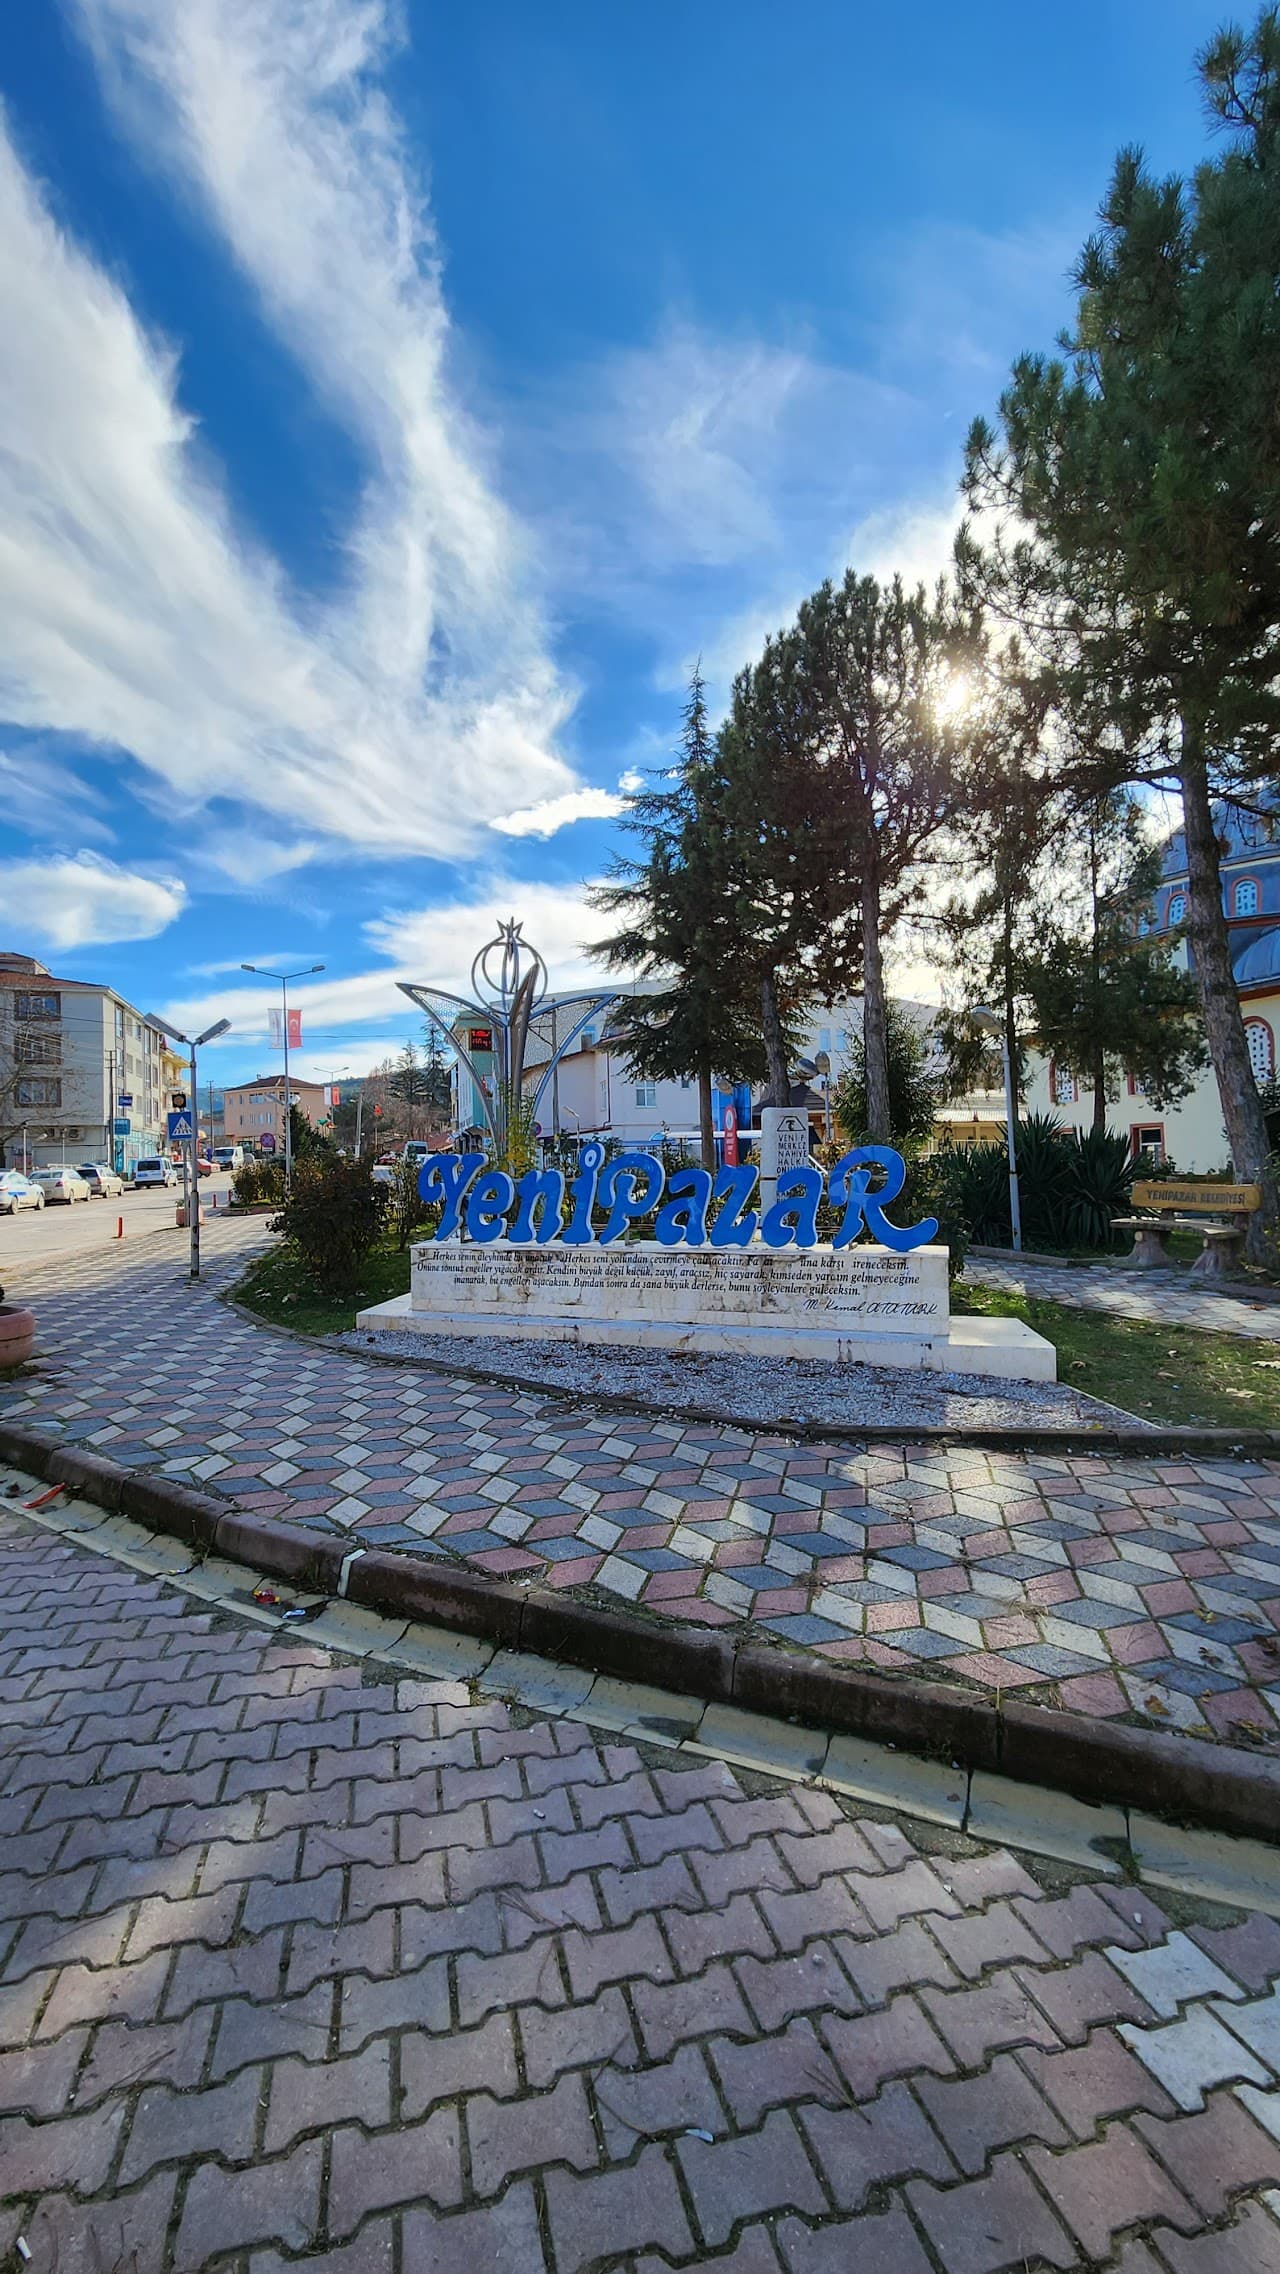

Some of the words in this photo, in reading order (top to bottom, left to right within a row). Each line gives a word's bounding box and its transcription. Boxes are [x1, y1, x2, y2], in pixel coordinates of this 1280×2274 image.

[433, 1250, 456, 1261] Herkes
[565, 1253, 590, 1263] Herkes
[611, 1253, 648, 1266] yolundan
[650, 1254, 691, 1267] çevirmeye
[821, 1256, 844, 1270] karşı
[441, 1263, 464, 1273] sonsuz
[466, 1263, 493, 1274] engeller
[605, 1266, 624, 1278] değil
[714, 1268, 727, 1280] hiç
[490, 1276, 499, 1285] bu
[574, 1278, 604, 1288] Bundan
[606, 1280, 628, 1288] sonra
[630, 1279, 640, 1288] da
[643, 1281, 662, 1289] sana
[824, 1300, 866, 1312] Kemal
